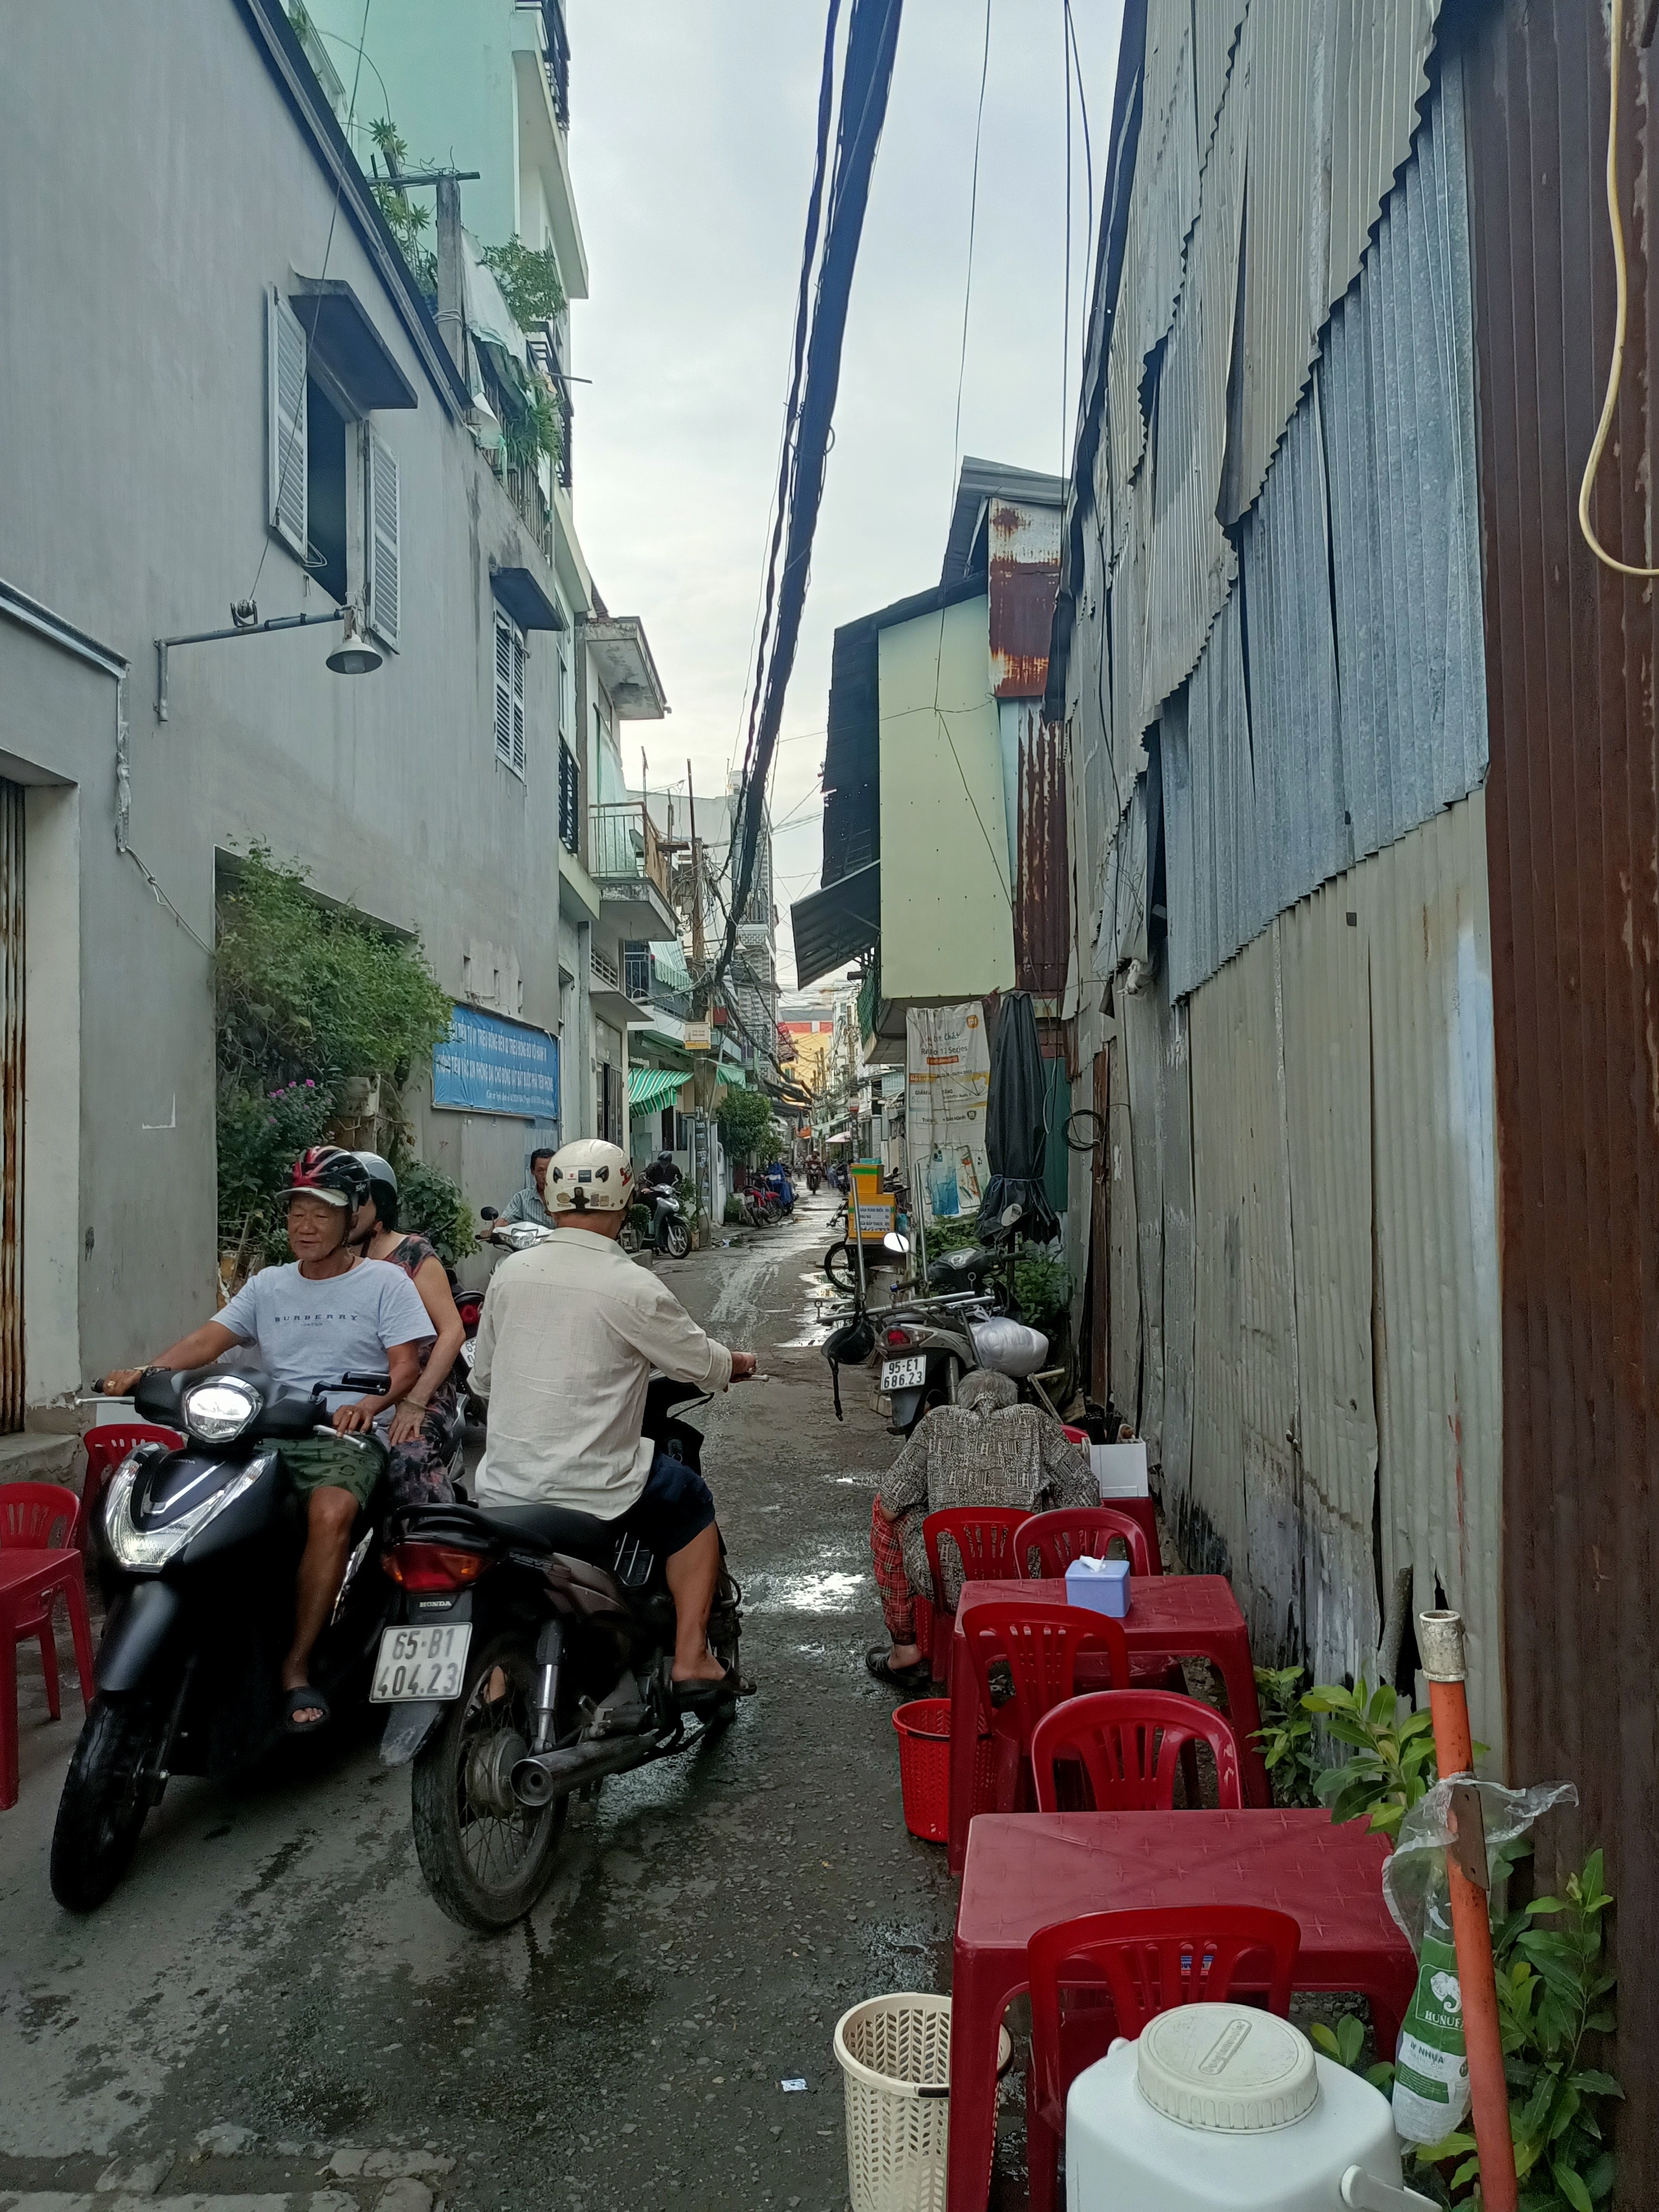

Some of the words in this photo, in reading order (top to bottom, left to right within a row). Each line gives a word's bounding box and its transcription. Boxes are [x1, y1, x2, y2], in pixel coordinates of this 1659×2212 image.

[275, 1314, 358, 1323] BURBERRY
[889, 1358, 918, 1374] 95-E1
[884, 1371, 922, 1389] 686.23
[377, 1662, 460, 1697] 404.23
[1418, 2046, 1444, 2064] NHỰA
